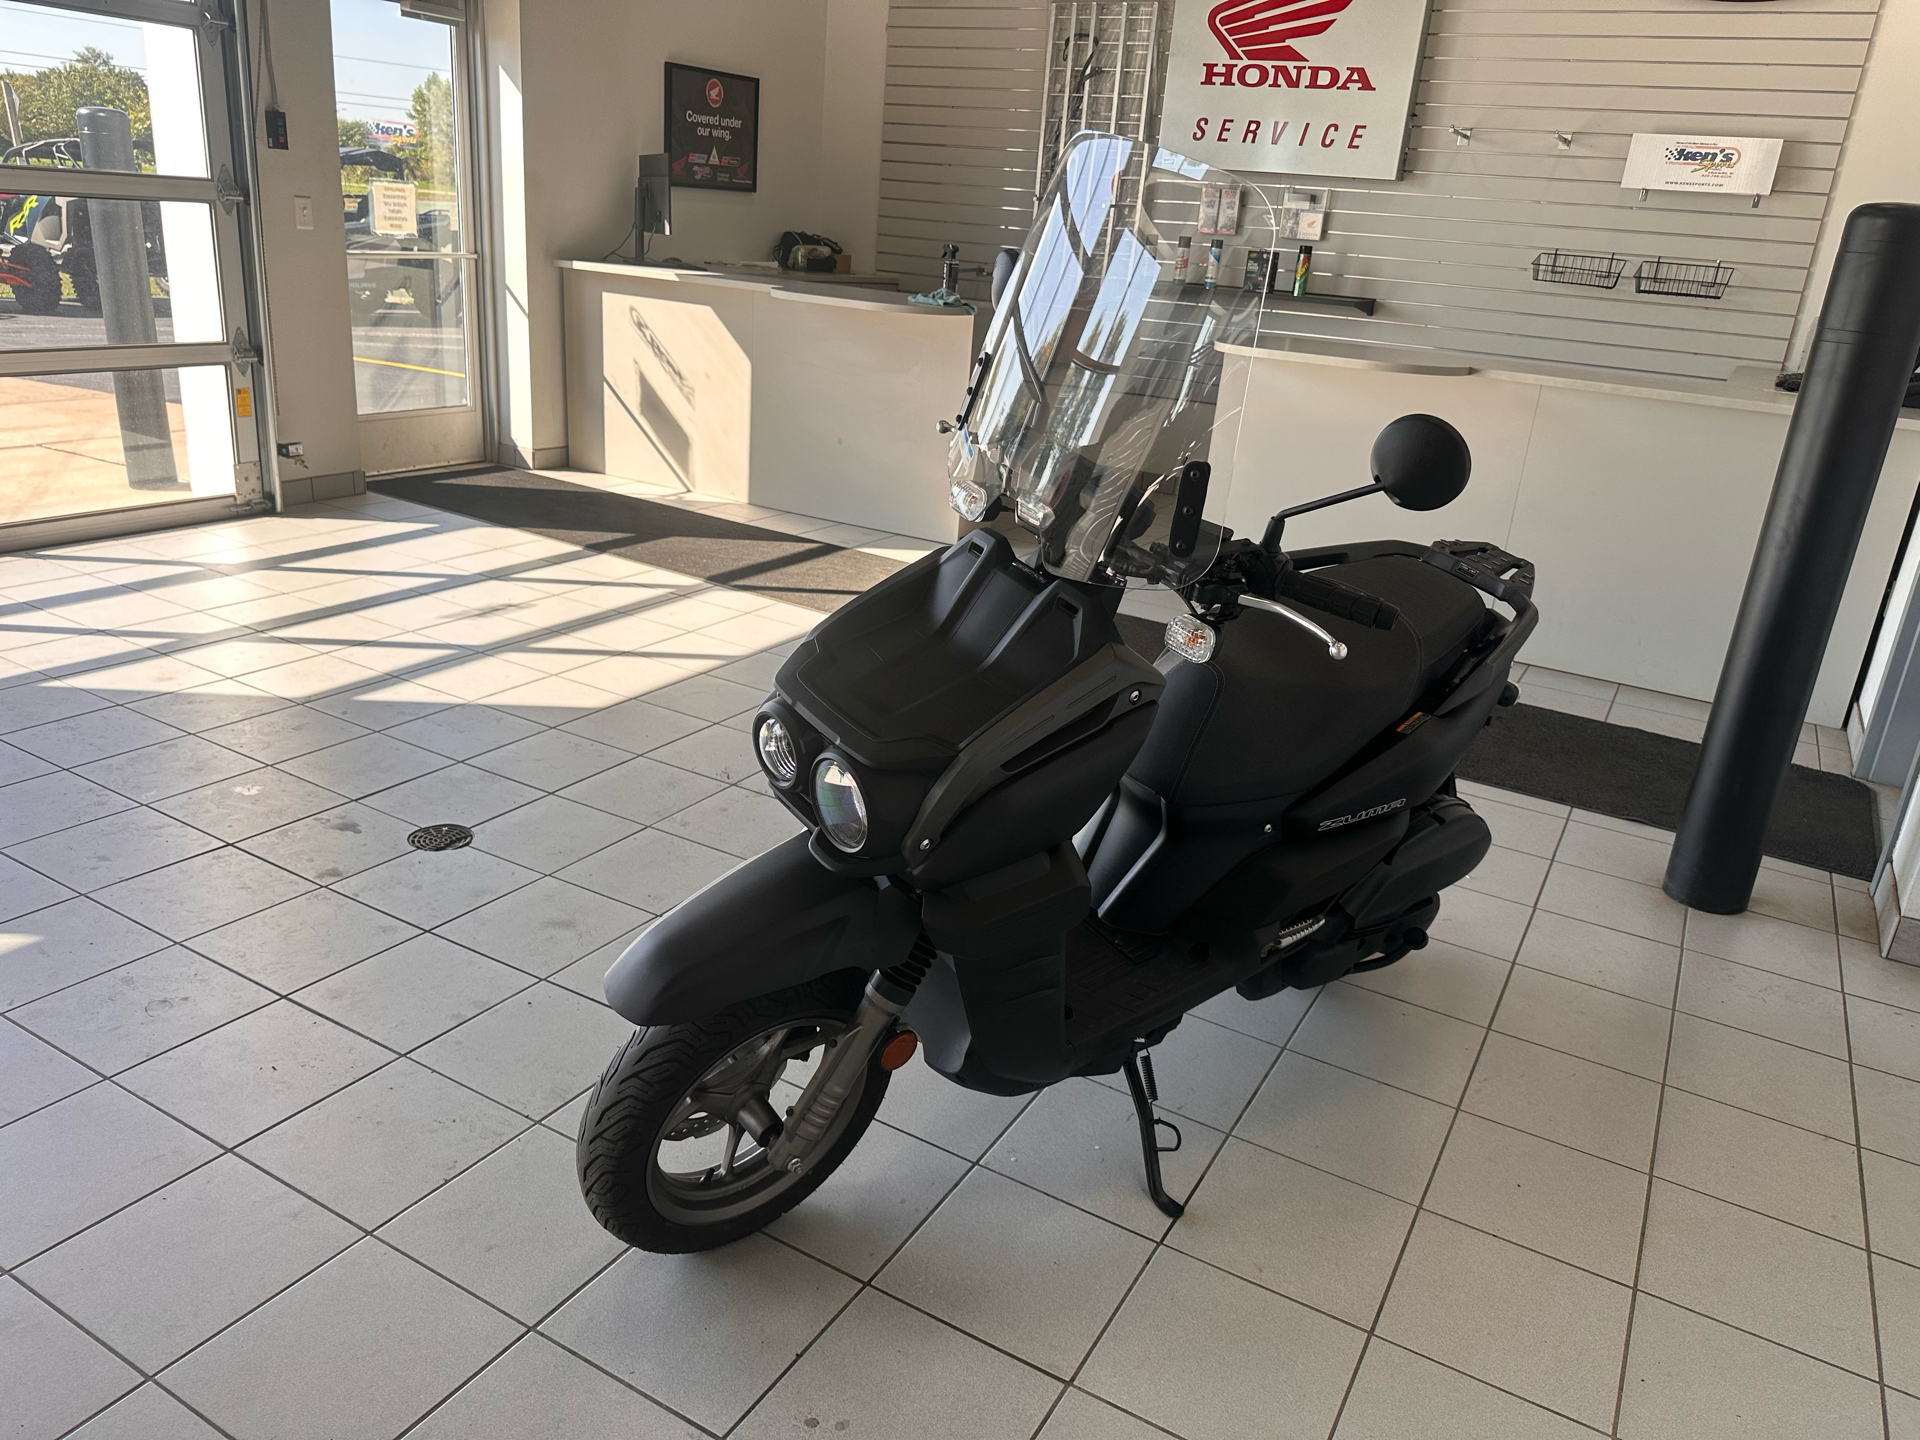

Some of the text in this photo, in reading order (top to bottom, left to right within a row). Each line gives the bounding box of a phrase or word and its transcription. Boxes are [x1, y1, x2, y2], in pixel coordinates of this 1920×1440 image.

[1200, 63, 1376, 91] HONDA
[686, 110, 742, 128] Covered under
[697, 126, 731, 141] our wing.
[1192, 117, 1367, 149] SERVICE
[1675, 148, 1734, 162] ken's
[1318, 798, 1406, 832] ZUMA
